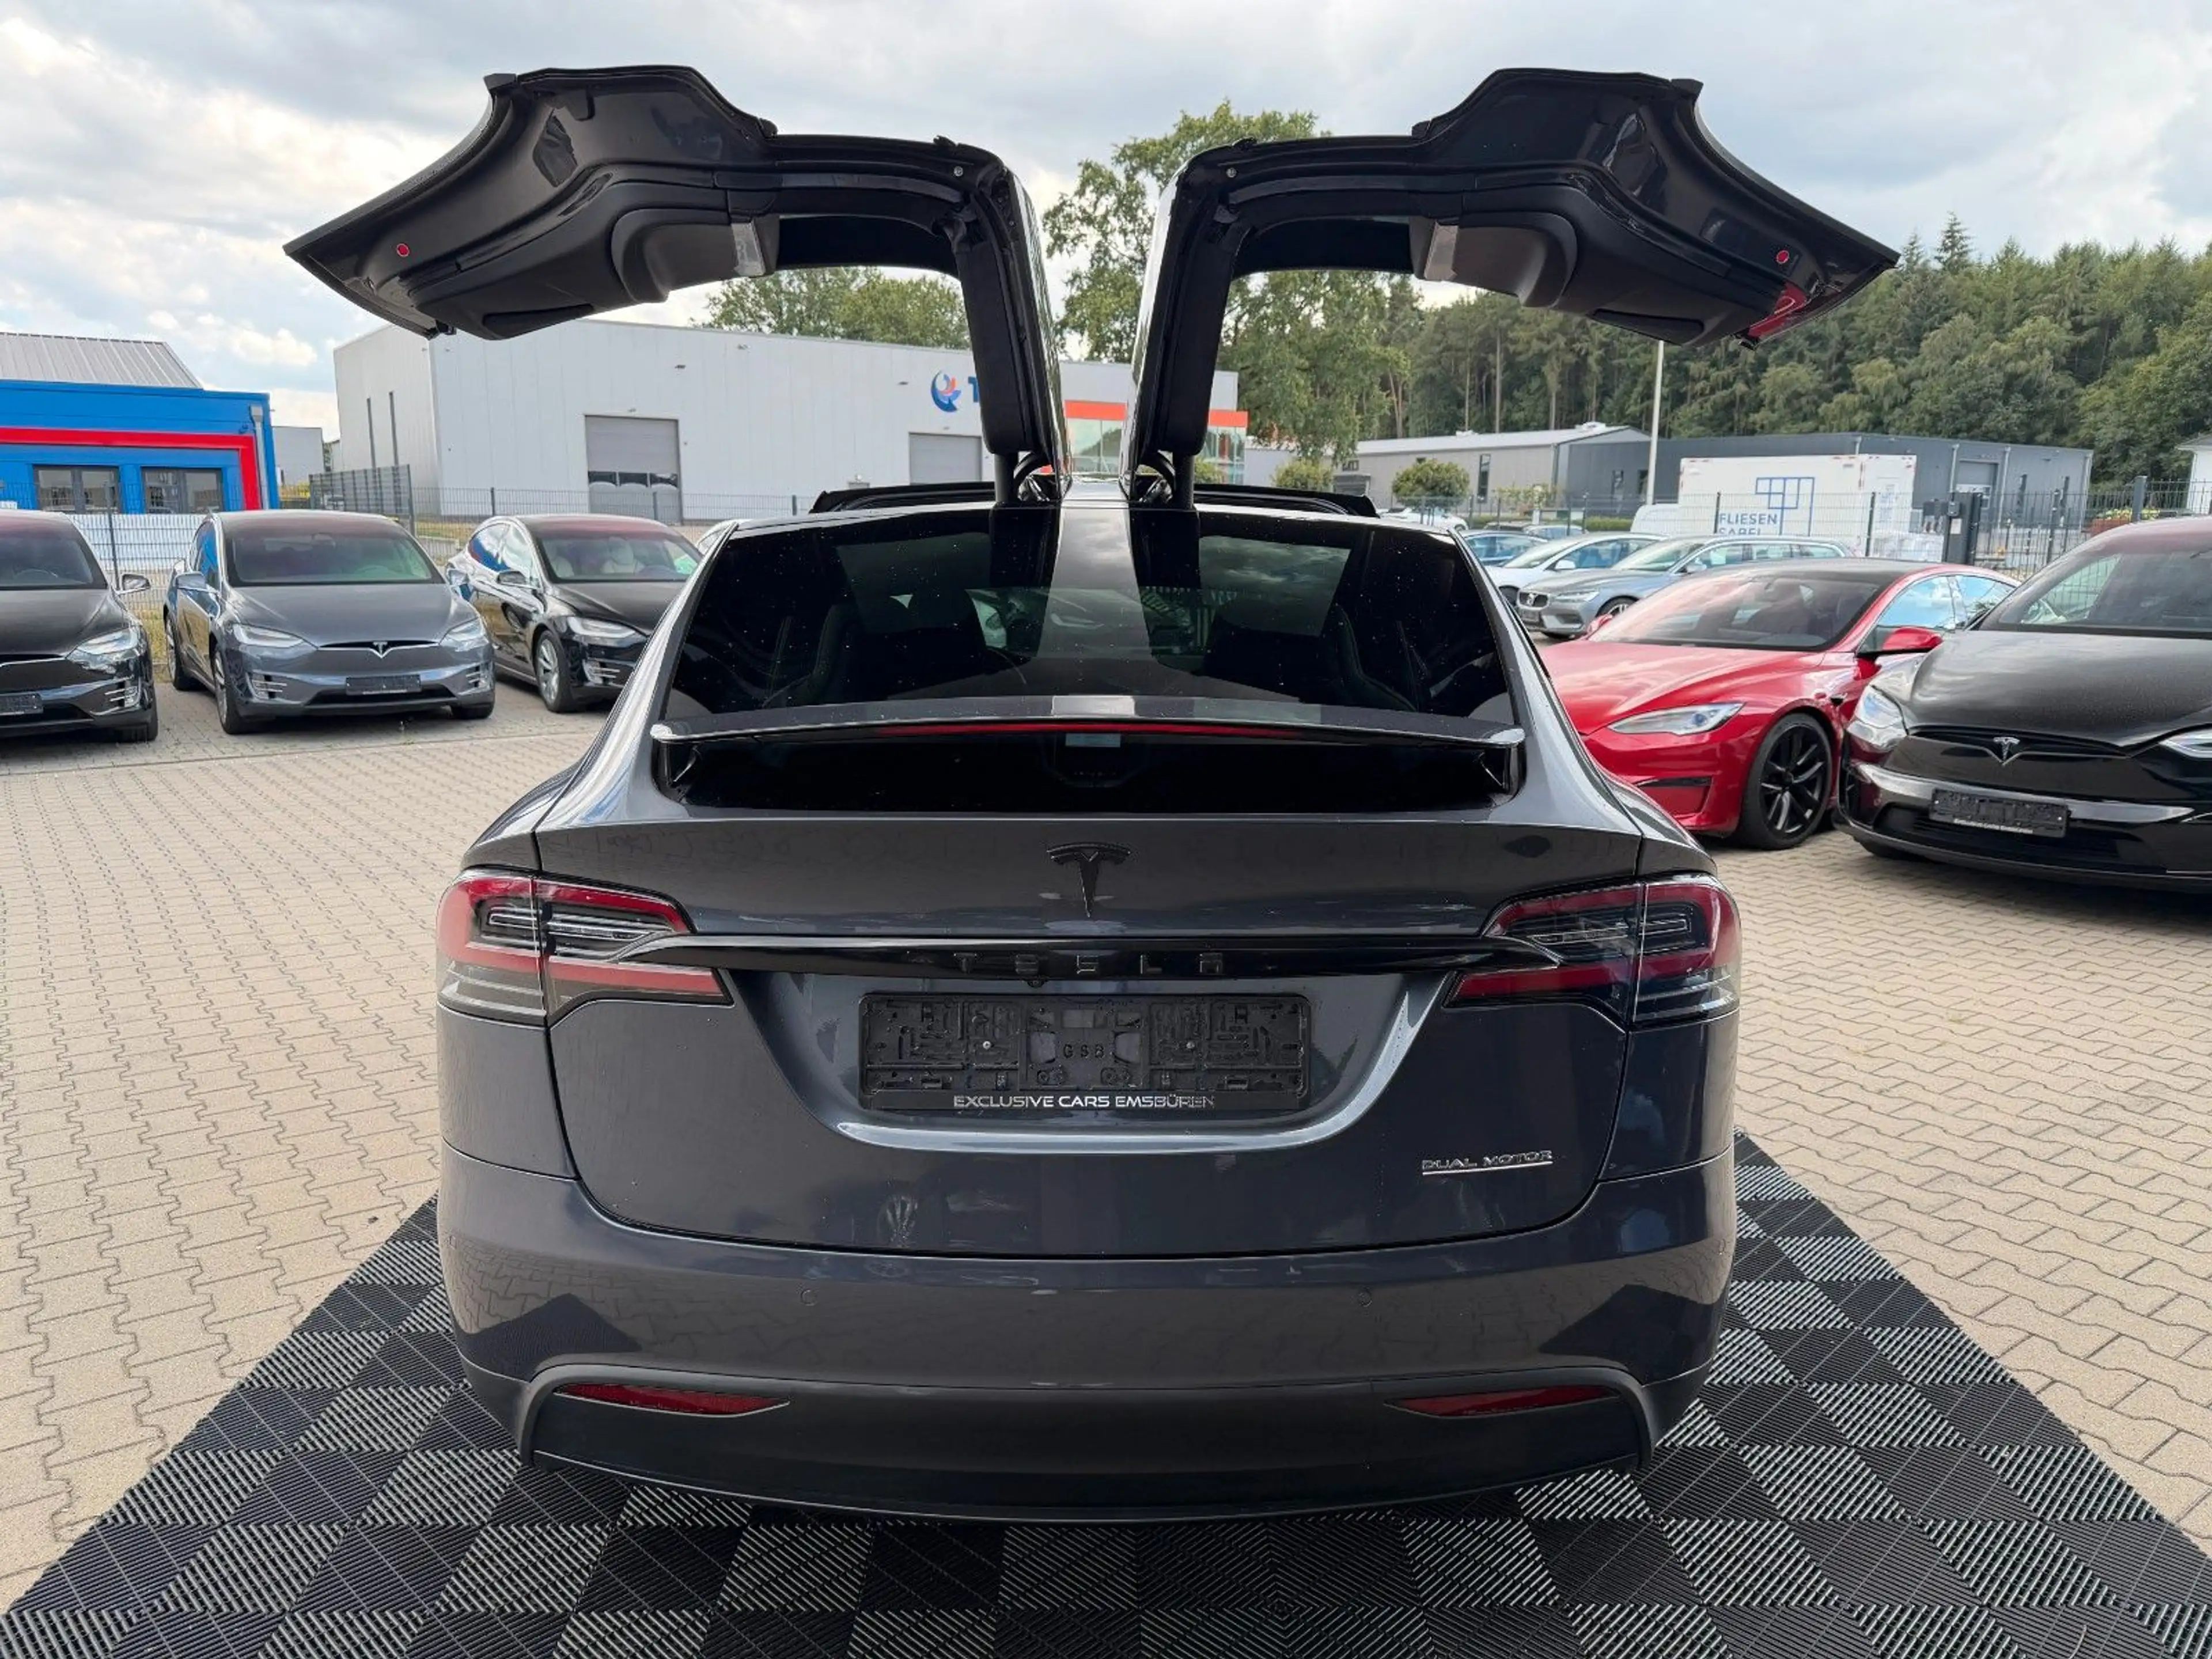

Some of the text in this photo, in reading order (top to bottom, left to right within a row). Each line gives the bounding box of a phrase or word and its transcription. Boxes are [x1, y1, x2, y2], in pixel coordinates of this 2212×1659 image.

[1719, 513, 1777, 524] FLIESEN
[953, 952, 1224, 975] TESLA
[953, 1093, 1214, 1108] EXCLUSIVE CARS EMSBÜREN
[1422, 1150, 1552, 1170] DUAL MOTOR
